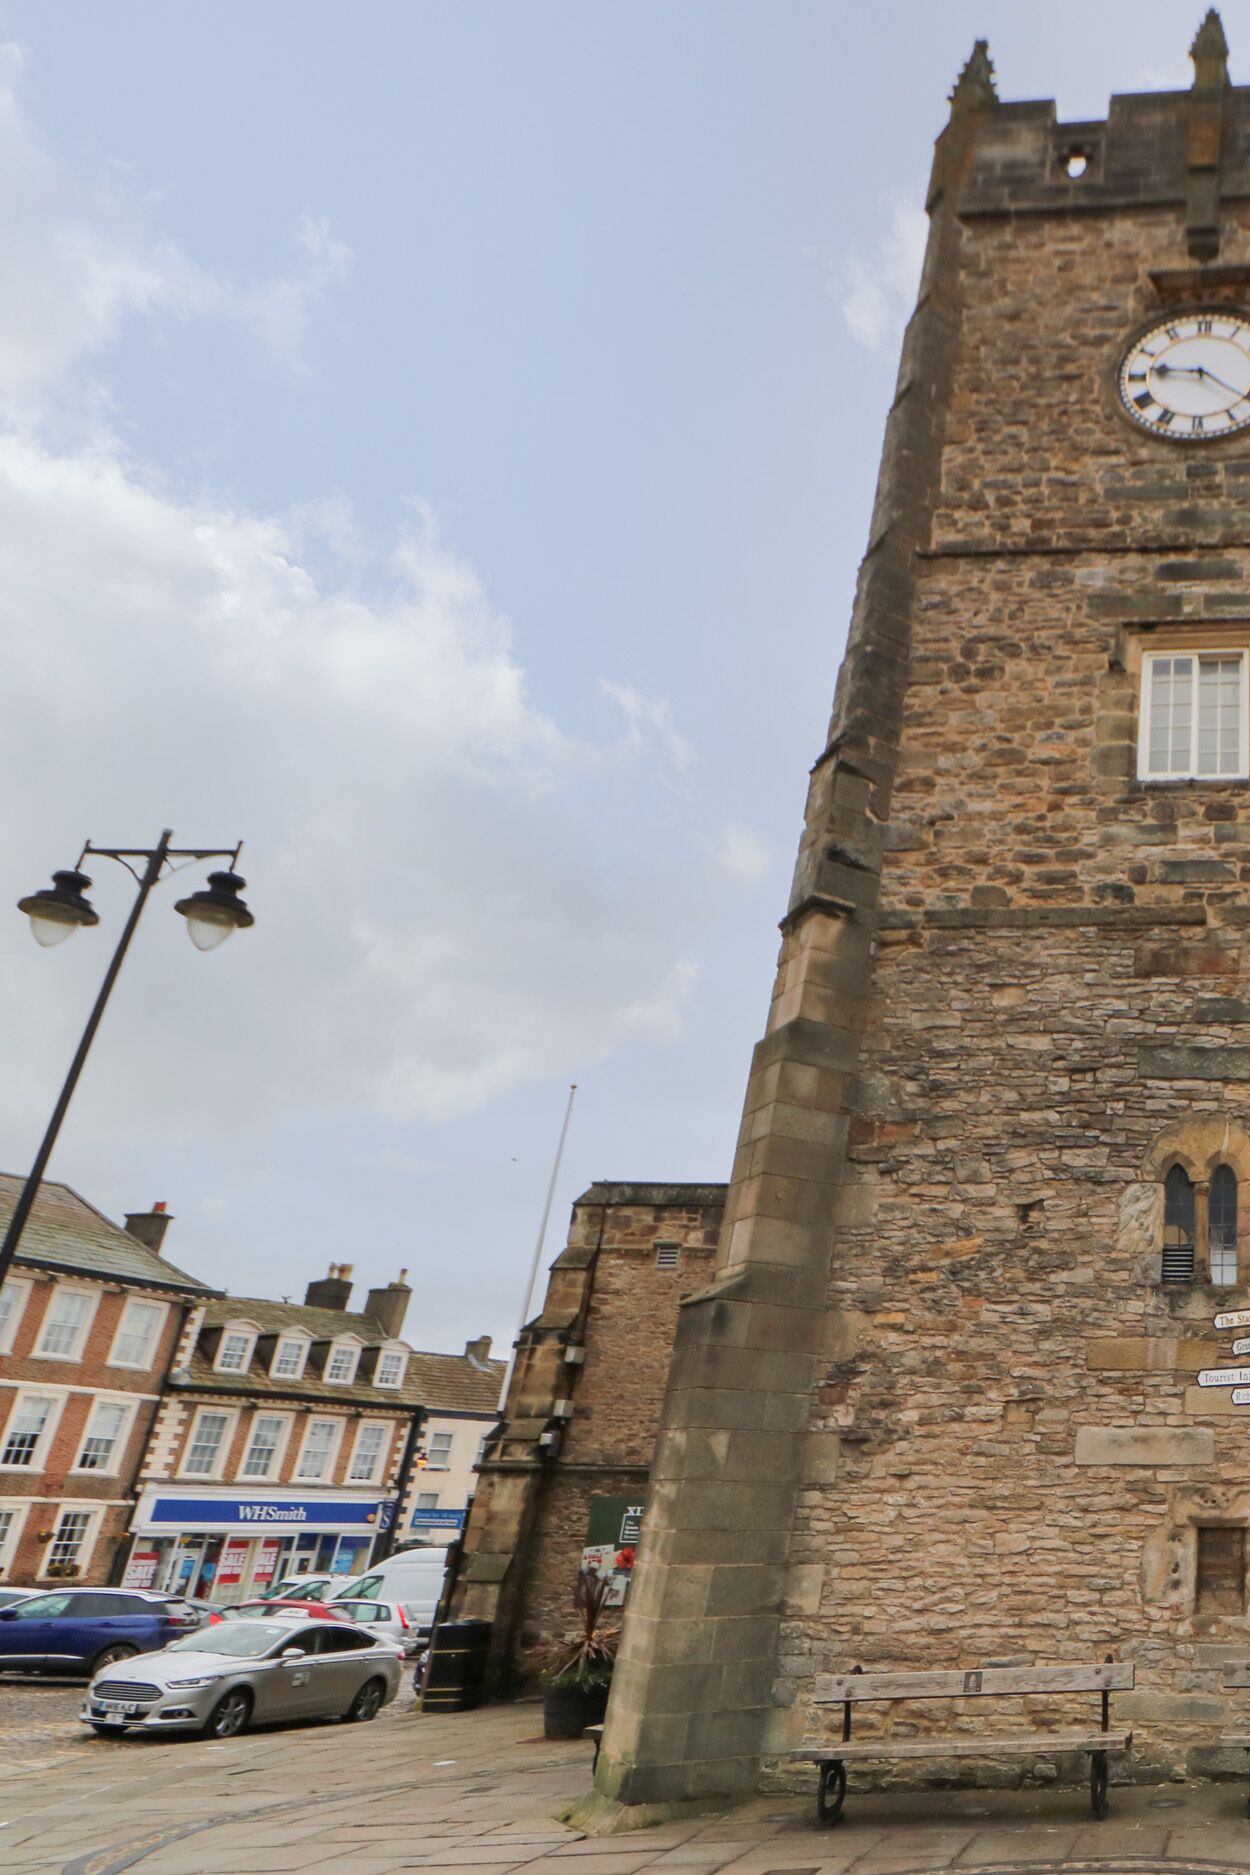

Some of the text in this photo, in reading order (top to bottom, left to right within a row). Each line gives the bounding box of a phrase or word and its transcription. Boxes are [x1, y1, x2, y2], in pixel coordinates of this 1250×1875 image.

[1197, 320, 1212, 333] XII
[1218, 1316, 1235, 1327] The
[1204, 1372, 1235, 1383] Tourist
[238, 1505, 307, 1521] WHSmith
[126, 1566, 156, 1579] SALE
